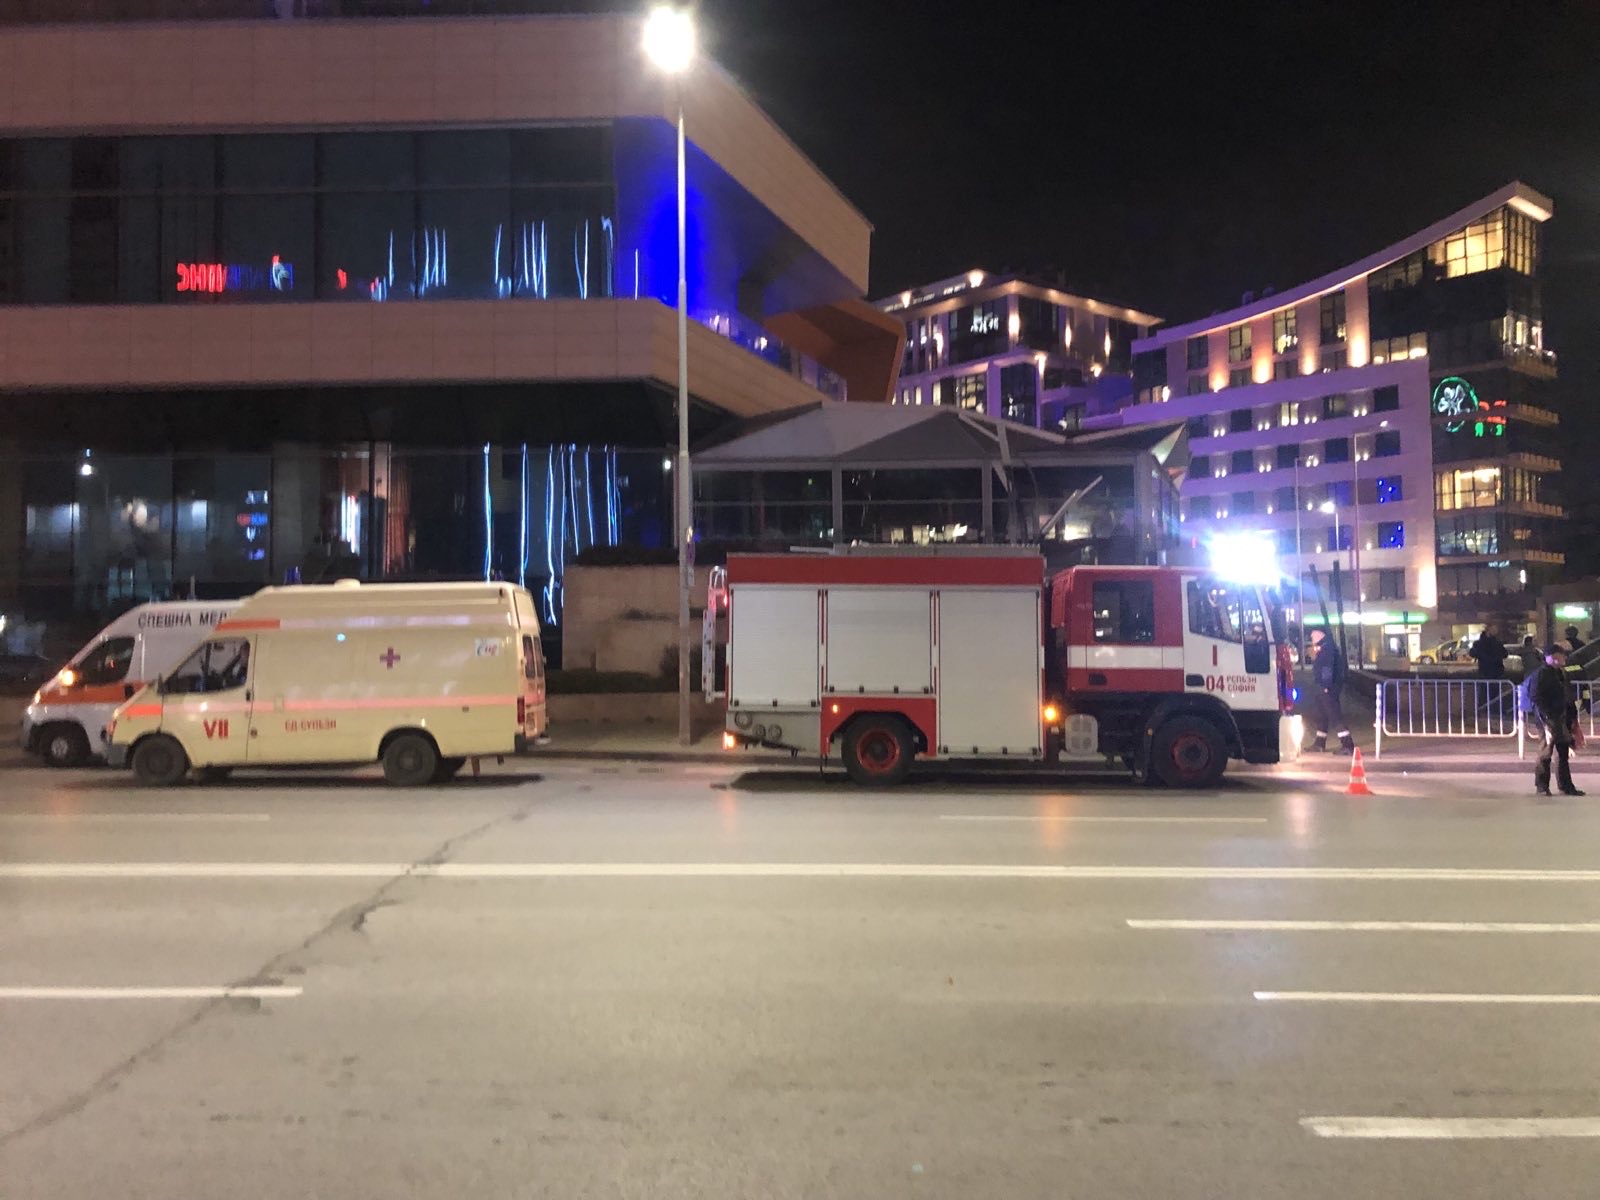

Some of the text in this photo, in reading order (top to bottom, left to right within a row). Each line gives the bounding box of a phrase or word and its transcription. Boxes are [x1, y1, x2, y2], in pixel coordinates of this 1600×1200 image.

[138, 612, 192, 628] СПЕШНА
[1206, 674, 1225, 692] 04
[203, 719, 229, 739] VII
